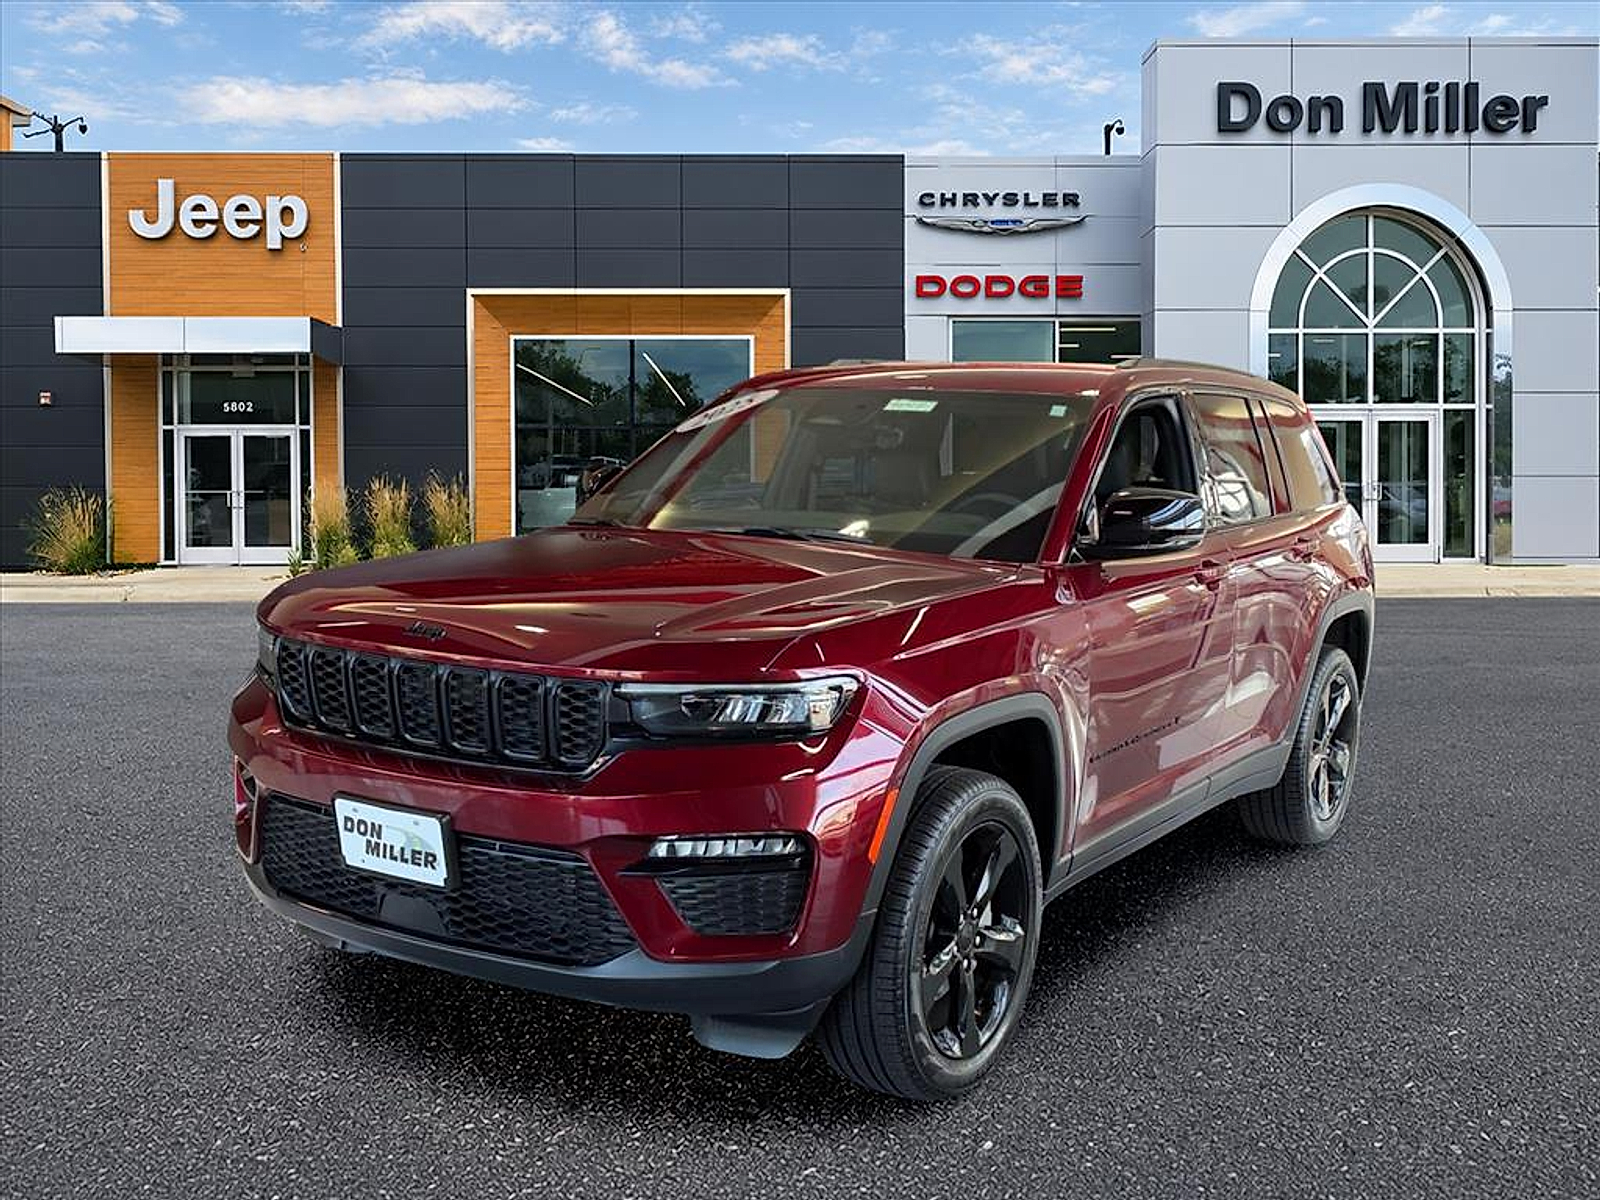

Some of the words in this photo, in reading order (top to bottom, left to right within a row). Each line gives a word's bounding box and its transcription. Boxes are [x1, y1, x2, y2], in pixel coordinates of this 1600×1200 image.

[1217, 81, 1344, 133] Don
[1362, 81, 1549, 133] Miller
[918, 192, 1081, 208] CHRYSLER
[128, 178, 309, 250] Jeep
[915, 275, 1083, 298] DODGE
[223, 401, 254, 413] 5802
[343, 815, 383, 840] DON
[365, 838, 438, 870] MILLER
